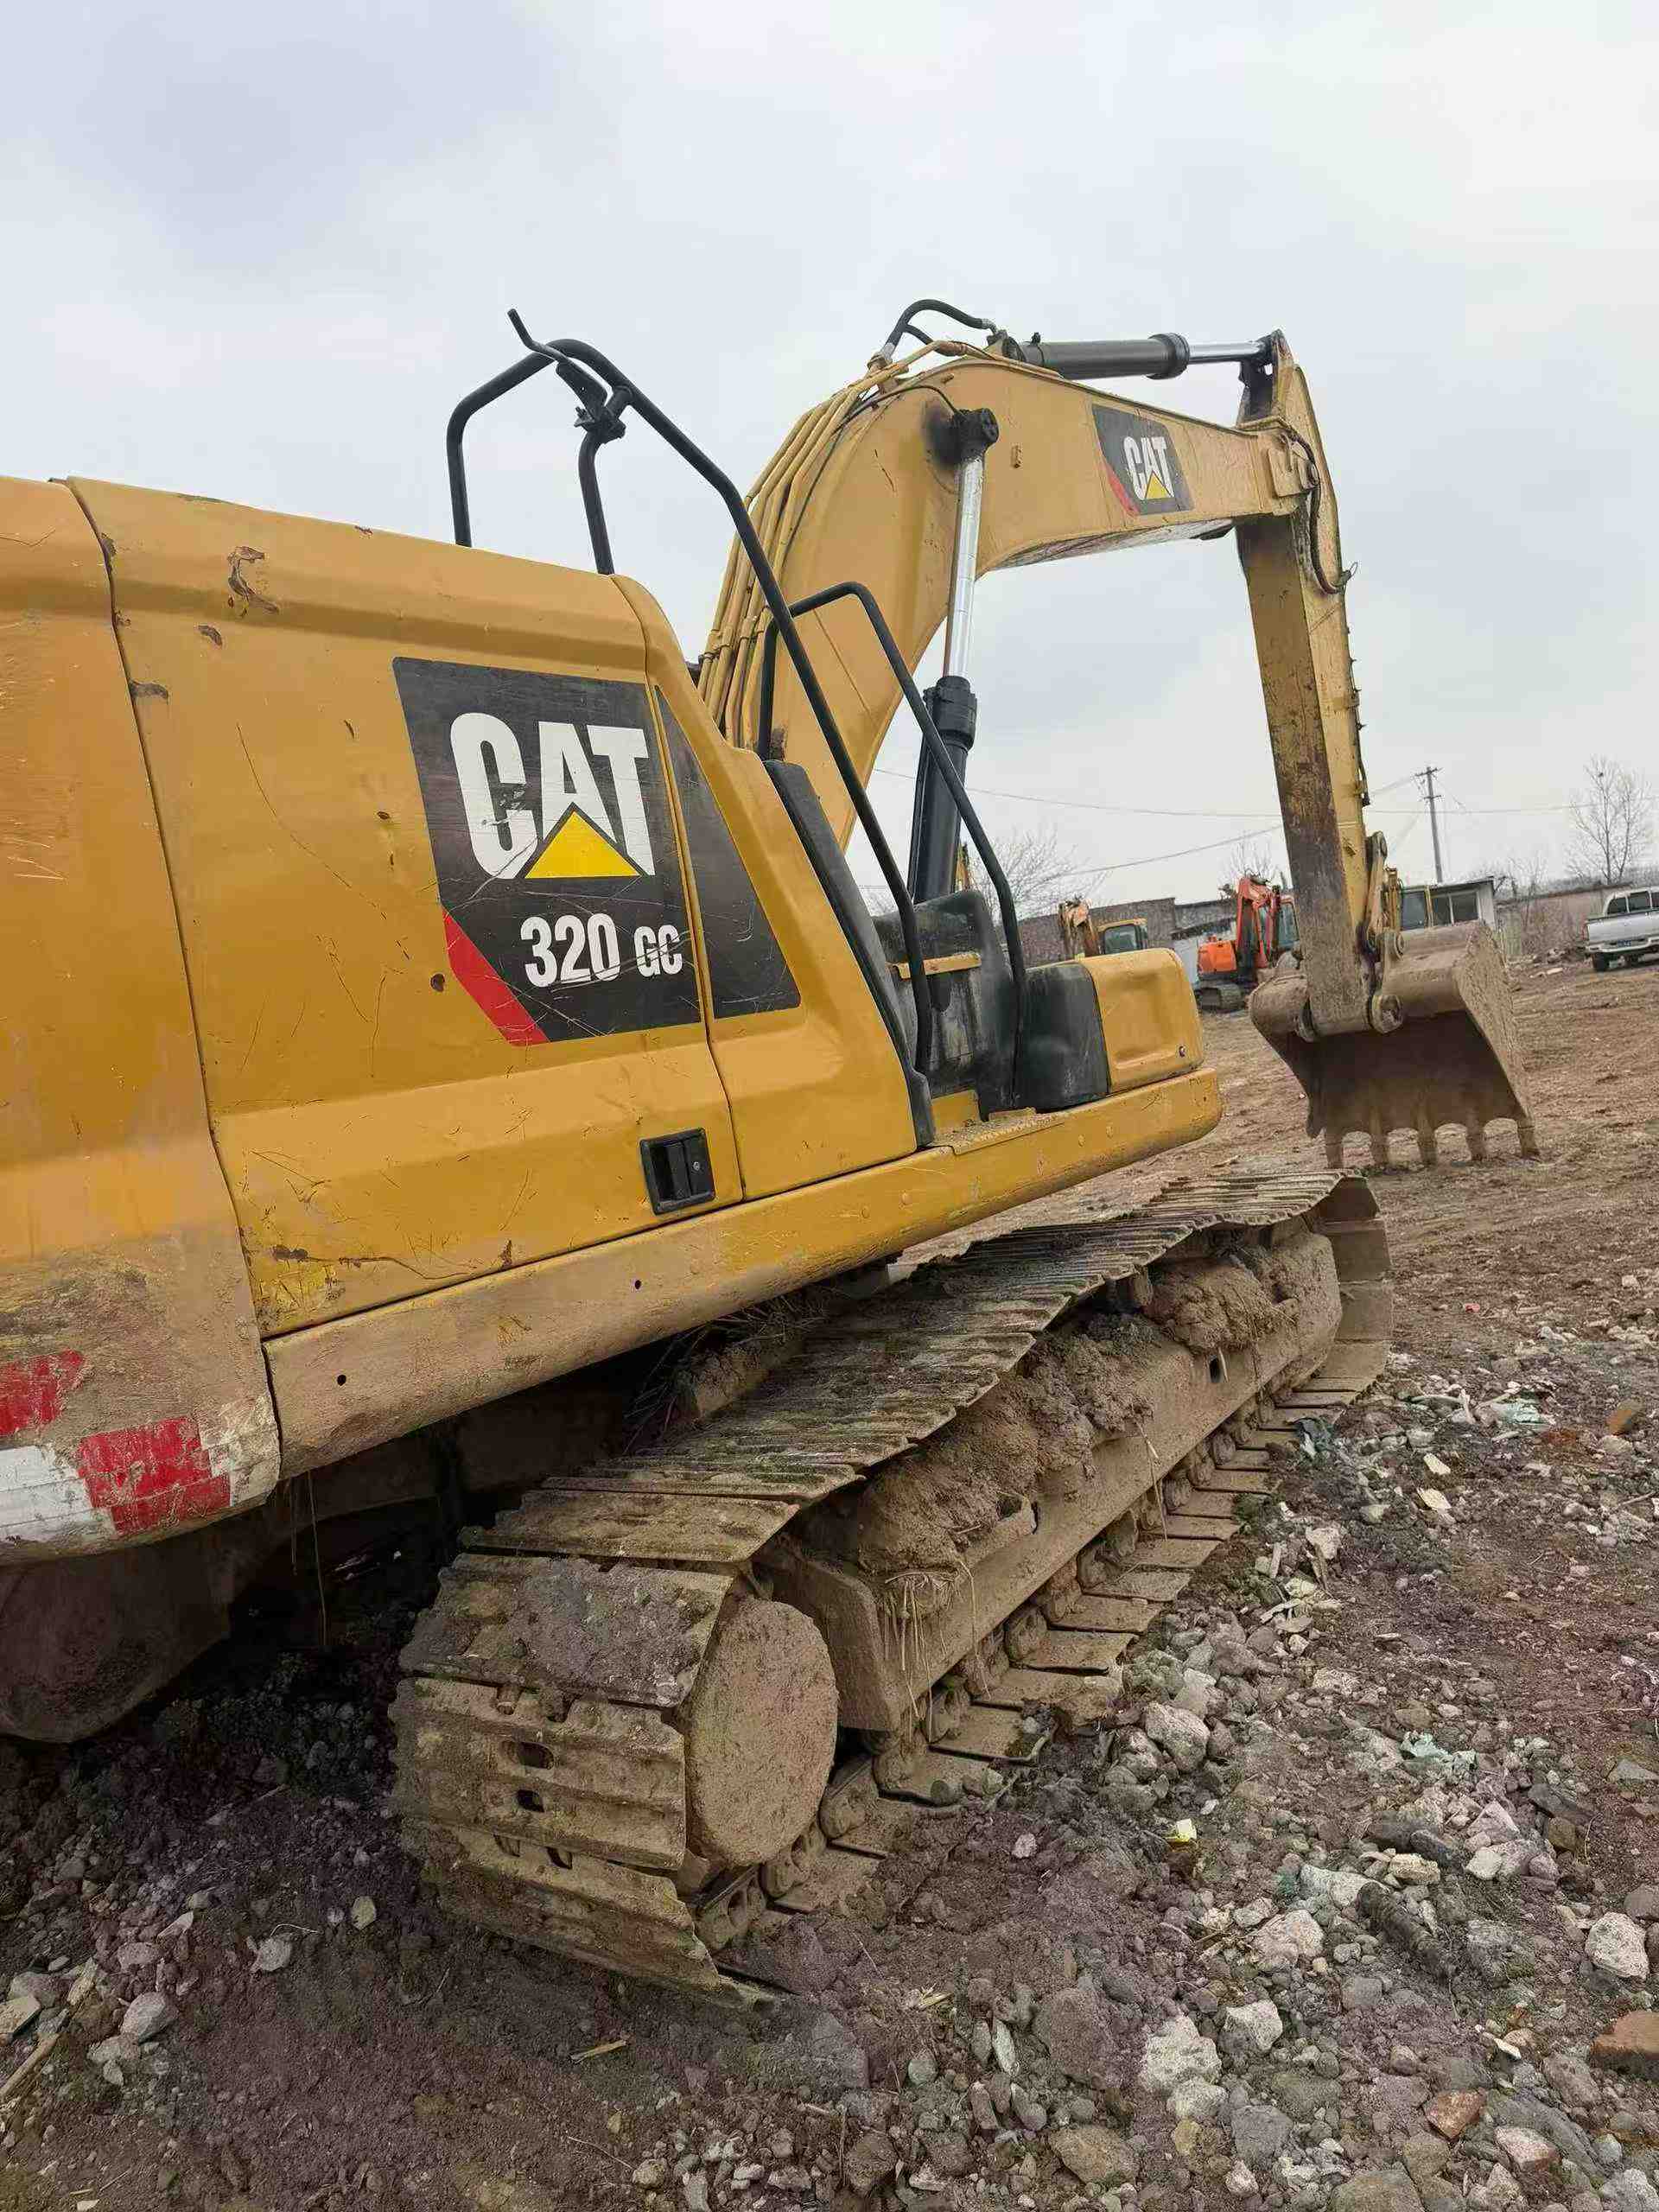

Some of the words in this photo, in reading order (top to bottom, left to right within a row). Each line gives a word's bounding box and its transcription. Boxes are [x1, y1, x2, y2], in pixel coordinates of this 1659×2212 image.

[1123, 436, 1174, 500] CAT
[449, 712, 655, 880] CAT
[520, 912, 621, 988] 320
[633, 924, 683, 977] GC
